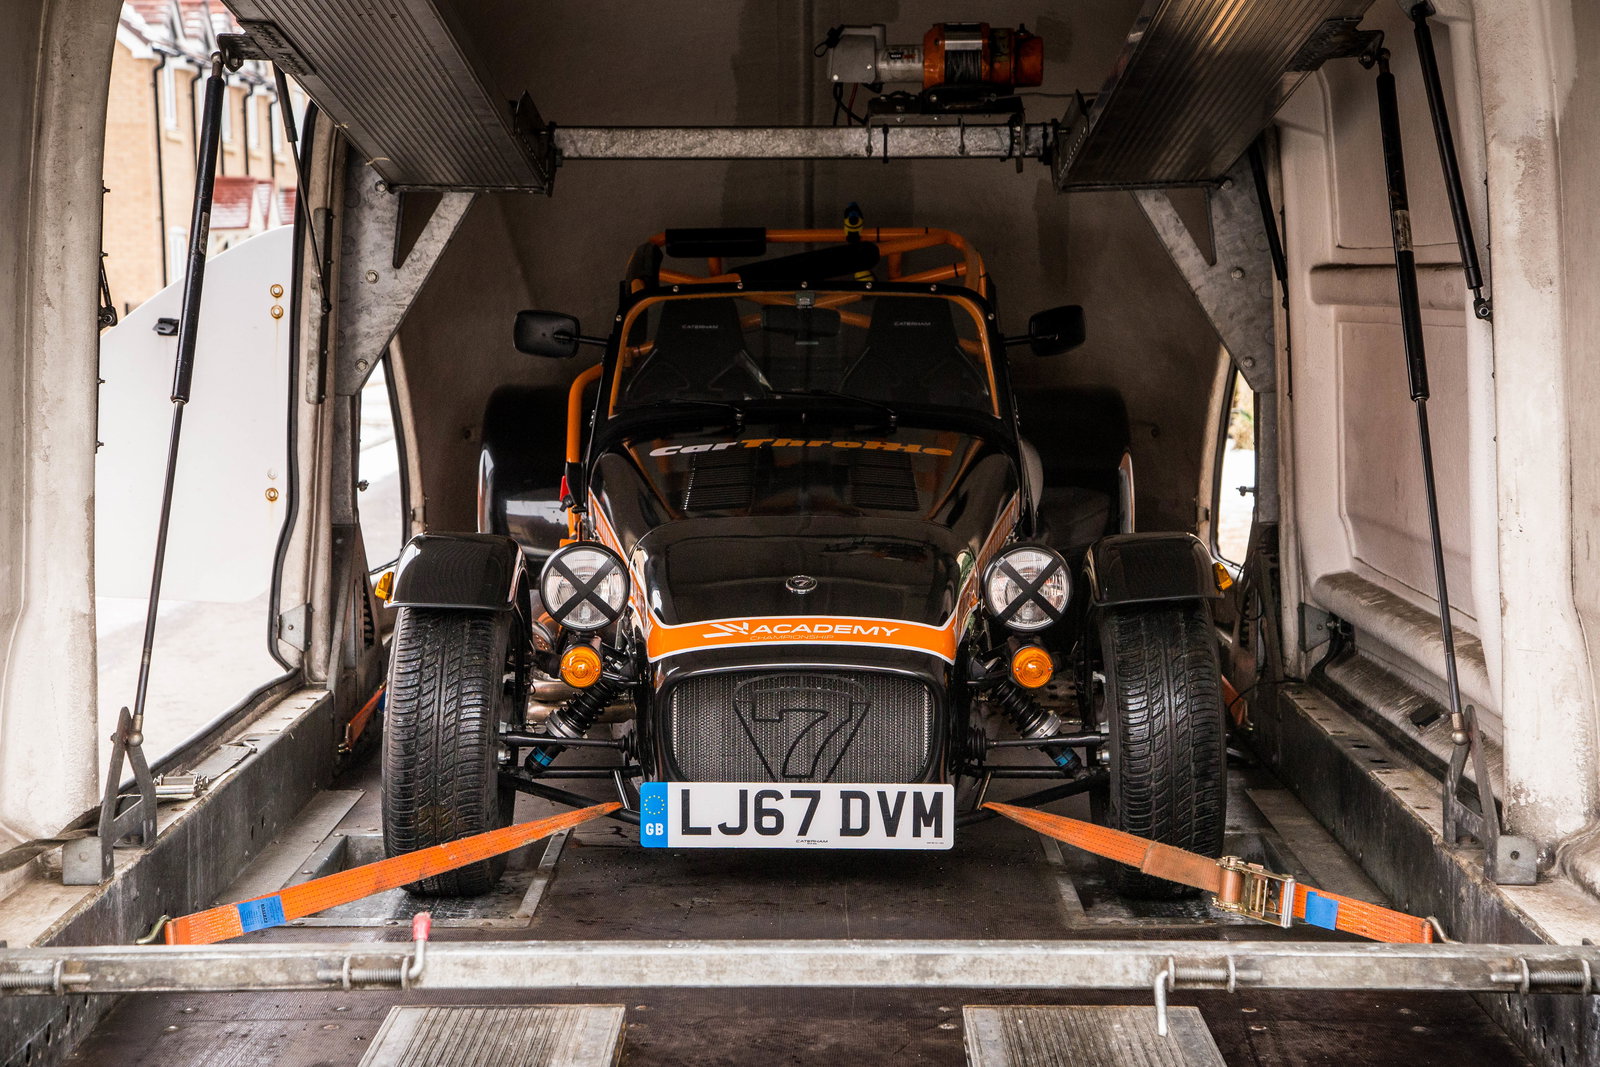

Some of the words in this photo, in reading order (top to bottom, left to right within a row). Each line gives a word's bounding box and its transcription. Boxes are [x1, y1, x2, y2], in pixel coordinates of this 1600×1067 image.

[751, 623, 901, 637] ACADEMY
[752, 689, 853, 779] 7
[681, 789, 821, 836] LJ67
[839, 790, 944, 838] DVM
[645, 823, 664, 836] GB
